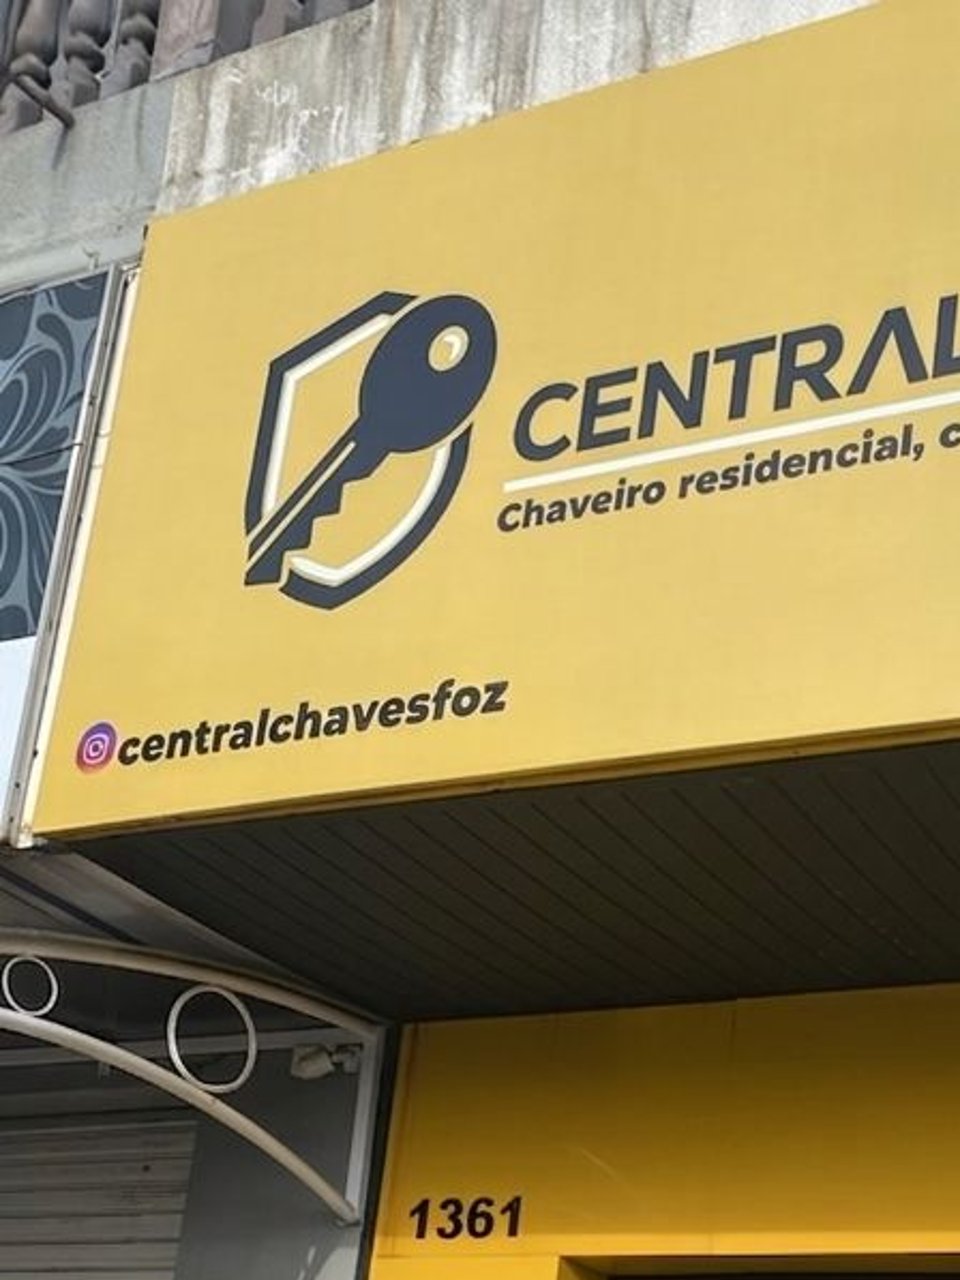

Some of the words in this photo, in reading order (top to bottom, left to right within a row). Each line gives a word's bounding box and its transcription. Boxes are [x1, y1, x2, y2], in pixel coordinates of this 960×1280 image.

[498, 478, 665, 533] Chaveiro
[678, 424, 925, 498] residencial,
[117, 679, 510, 766] centralchavesfoz
[409, 1196, 523, 1240] 1361
